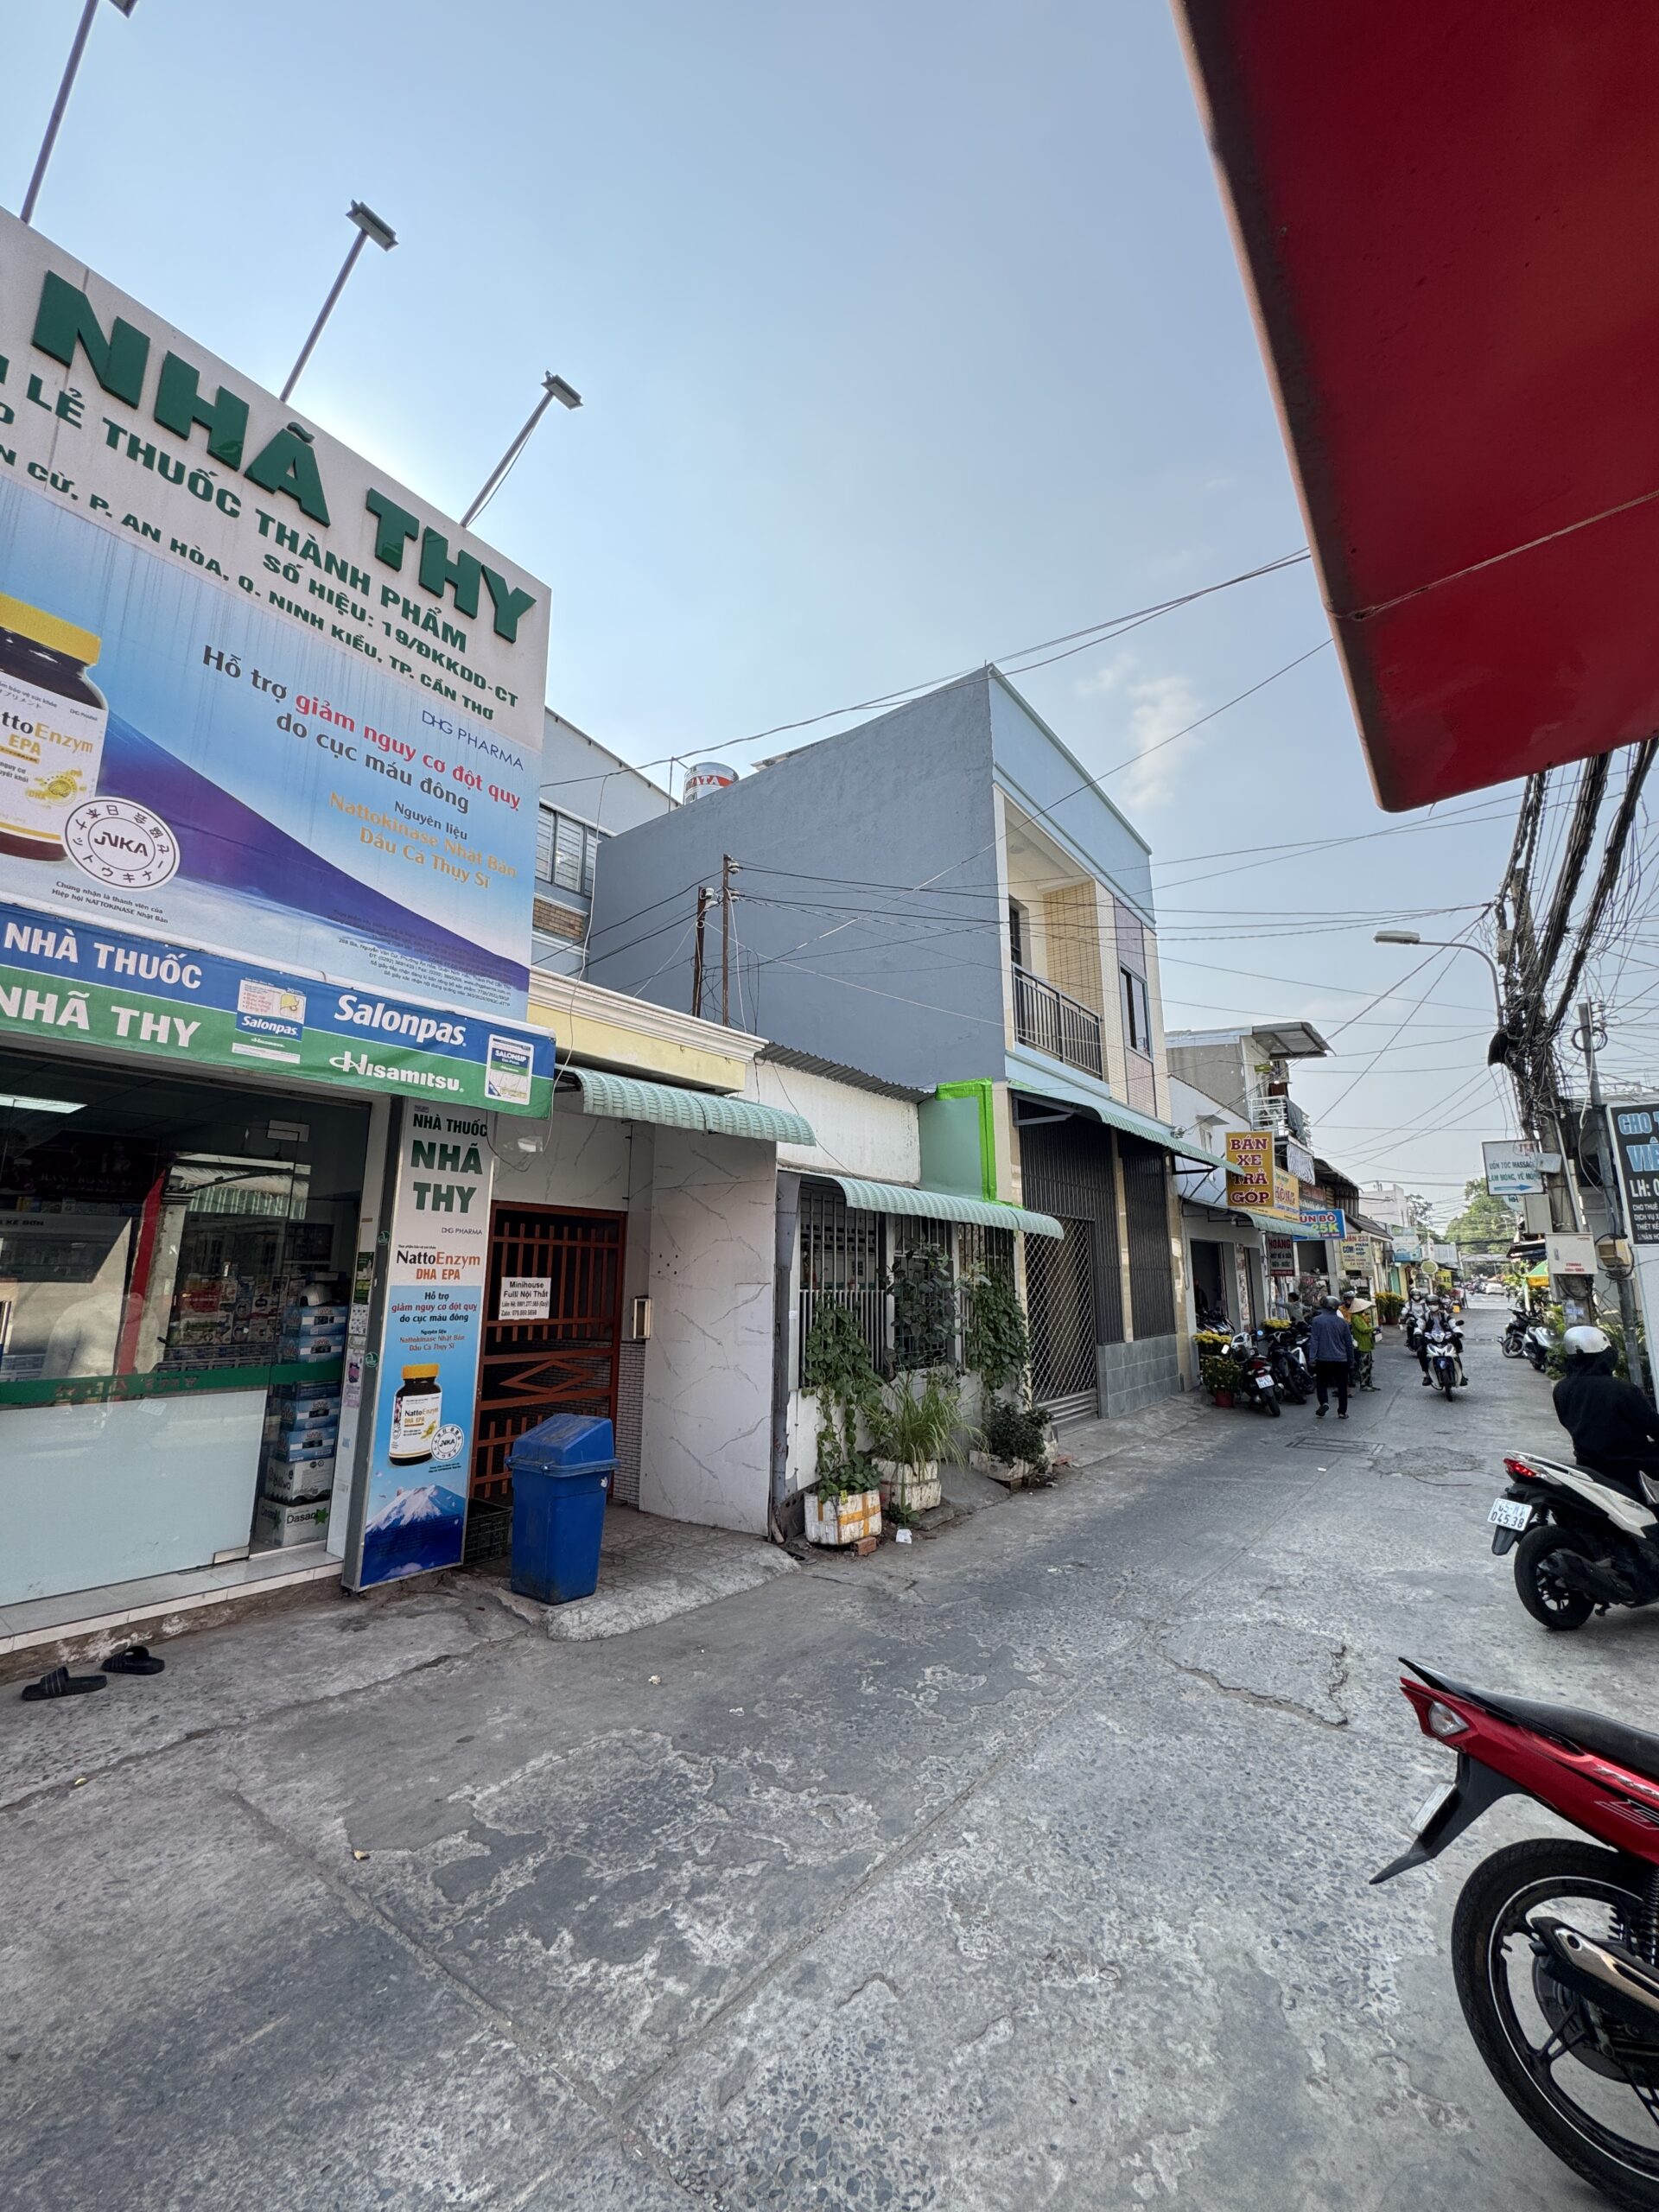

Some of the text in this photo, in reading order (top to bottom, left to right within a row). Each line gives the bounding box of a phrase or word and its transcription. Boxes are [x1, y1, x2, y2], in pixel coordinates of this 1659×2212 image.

[30, 270, 537, 644] NHÃ THY
[27, 373, 467, 653] LẺ THUỐC THÀNH PHẨM
[264, 554, 303, 584] SỐ
[308, 578, 374, 626] HIỆU:
[122, 513, 162, 543] AN
[170, 537, 229, 581] HÒA,
[269, 590, 325, 631] NINH
[390, 655, 414, 678] TP.
[462, 695, 494, 720] THƠ
[203, 645, 521, 812] Hỗ trợ giảm nguy cơ đột quỵ
[9, 734, 41, 756] EPA
[423, 710, 524, 771] DHG PHARMA
[276, 713, 469, 814] do cục máu đông
[330, 791, 439, 846] Nattokinase
[444, 838, 482, 865] Nhật
[395, 800, 467, 840] Nguyên liệu
[432, 854, 470, 884] Thụy
[52, 888, 168, 924] Hiệp hội NATTOKINASE Nhật Bản
[83, 887, 101, 899] nhận
[103, 892, 111, 900] là
[112, 895, 133, 907] thành
[134, 899, 149, 911] viên
[150, 905, 163, 914] của
[3, 922, 202, 989] NHÀ THUỐC
[111, 1005, 201, 1048] THY
[242, 1015, 298, 1037] Salonpas
[495, 1050, 527, 1063] SALONSIP
[413, 1114, 487, 1137] NHÀ THUỐC
[1618, 1112, 1652, 1135] CHO
[1230, 1135, 1268, 1150] BÁN
[410, 1140, 483, 1175] NHÃ
[1237, 1154, 1262, 1166] XE
[1232, 1169, 1268, 1185] TRẢ
[1630, 1179, 1650, 1197] LH:
[413, 1182, 477, 1214] THY
[1230, 1188, 1269, 1204] GÓP
[1644, 1202, 1659, 1211] THUÊ
[1299, 1213, 1318, 1224] ÚN
[1319, 1213, 1336, 1223] BÒ
[1311, 1224, 1339, 1234] 25K
[397, 1250, 480, 1269] NattoEnzym
[416, 1268, 461, 1281] DHA EPA
[391, 1303, 413, 1313] giảm
[416, 1305, 435, 1313] nguy
[449, 1303, 461, 1312] đột
[438, 1292, 449, 1301] trợ
[399, 1314, 410, 1323] do
[413, 1315, 427, 1324] cục
[1491, 1511, 1525, 1529] 045.38
